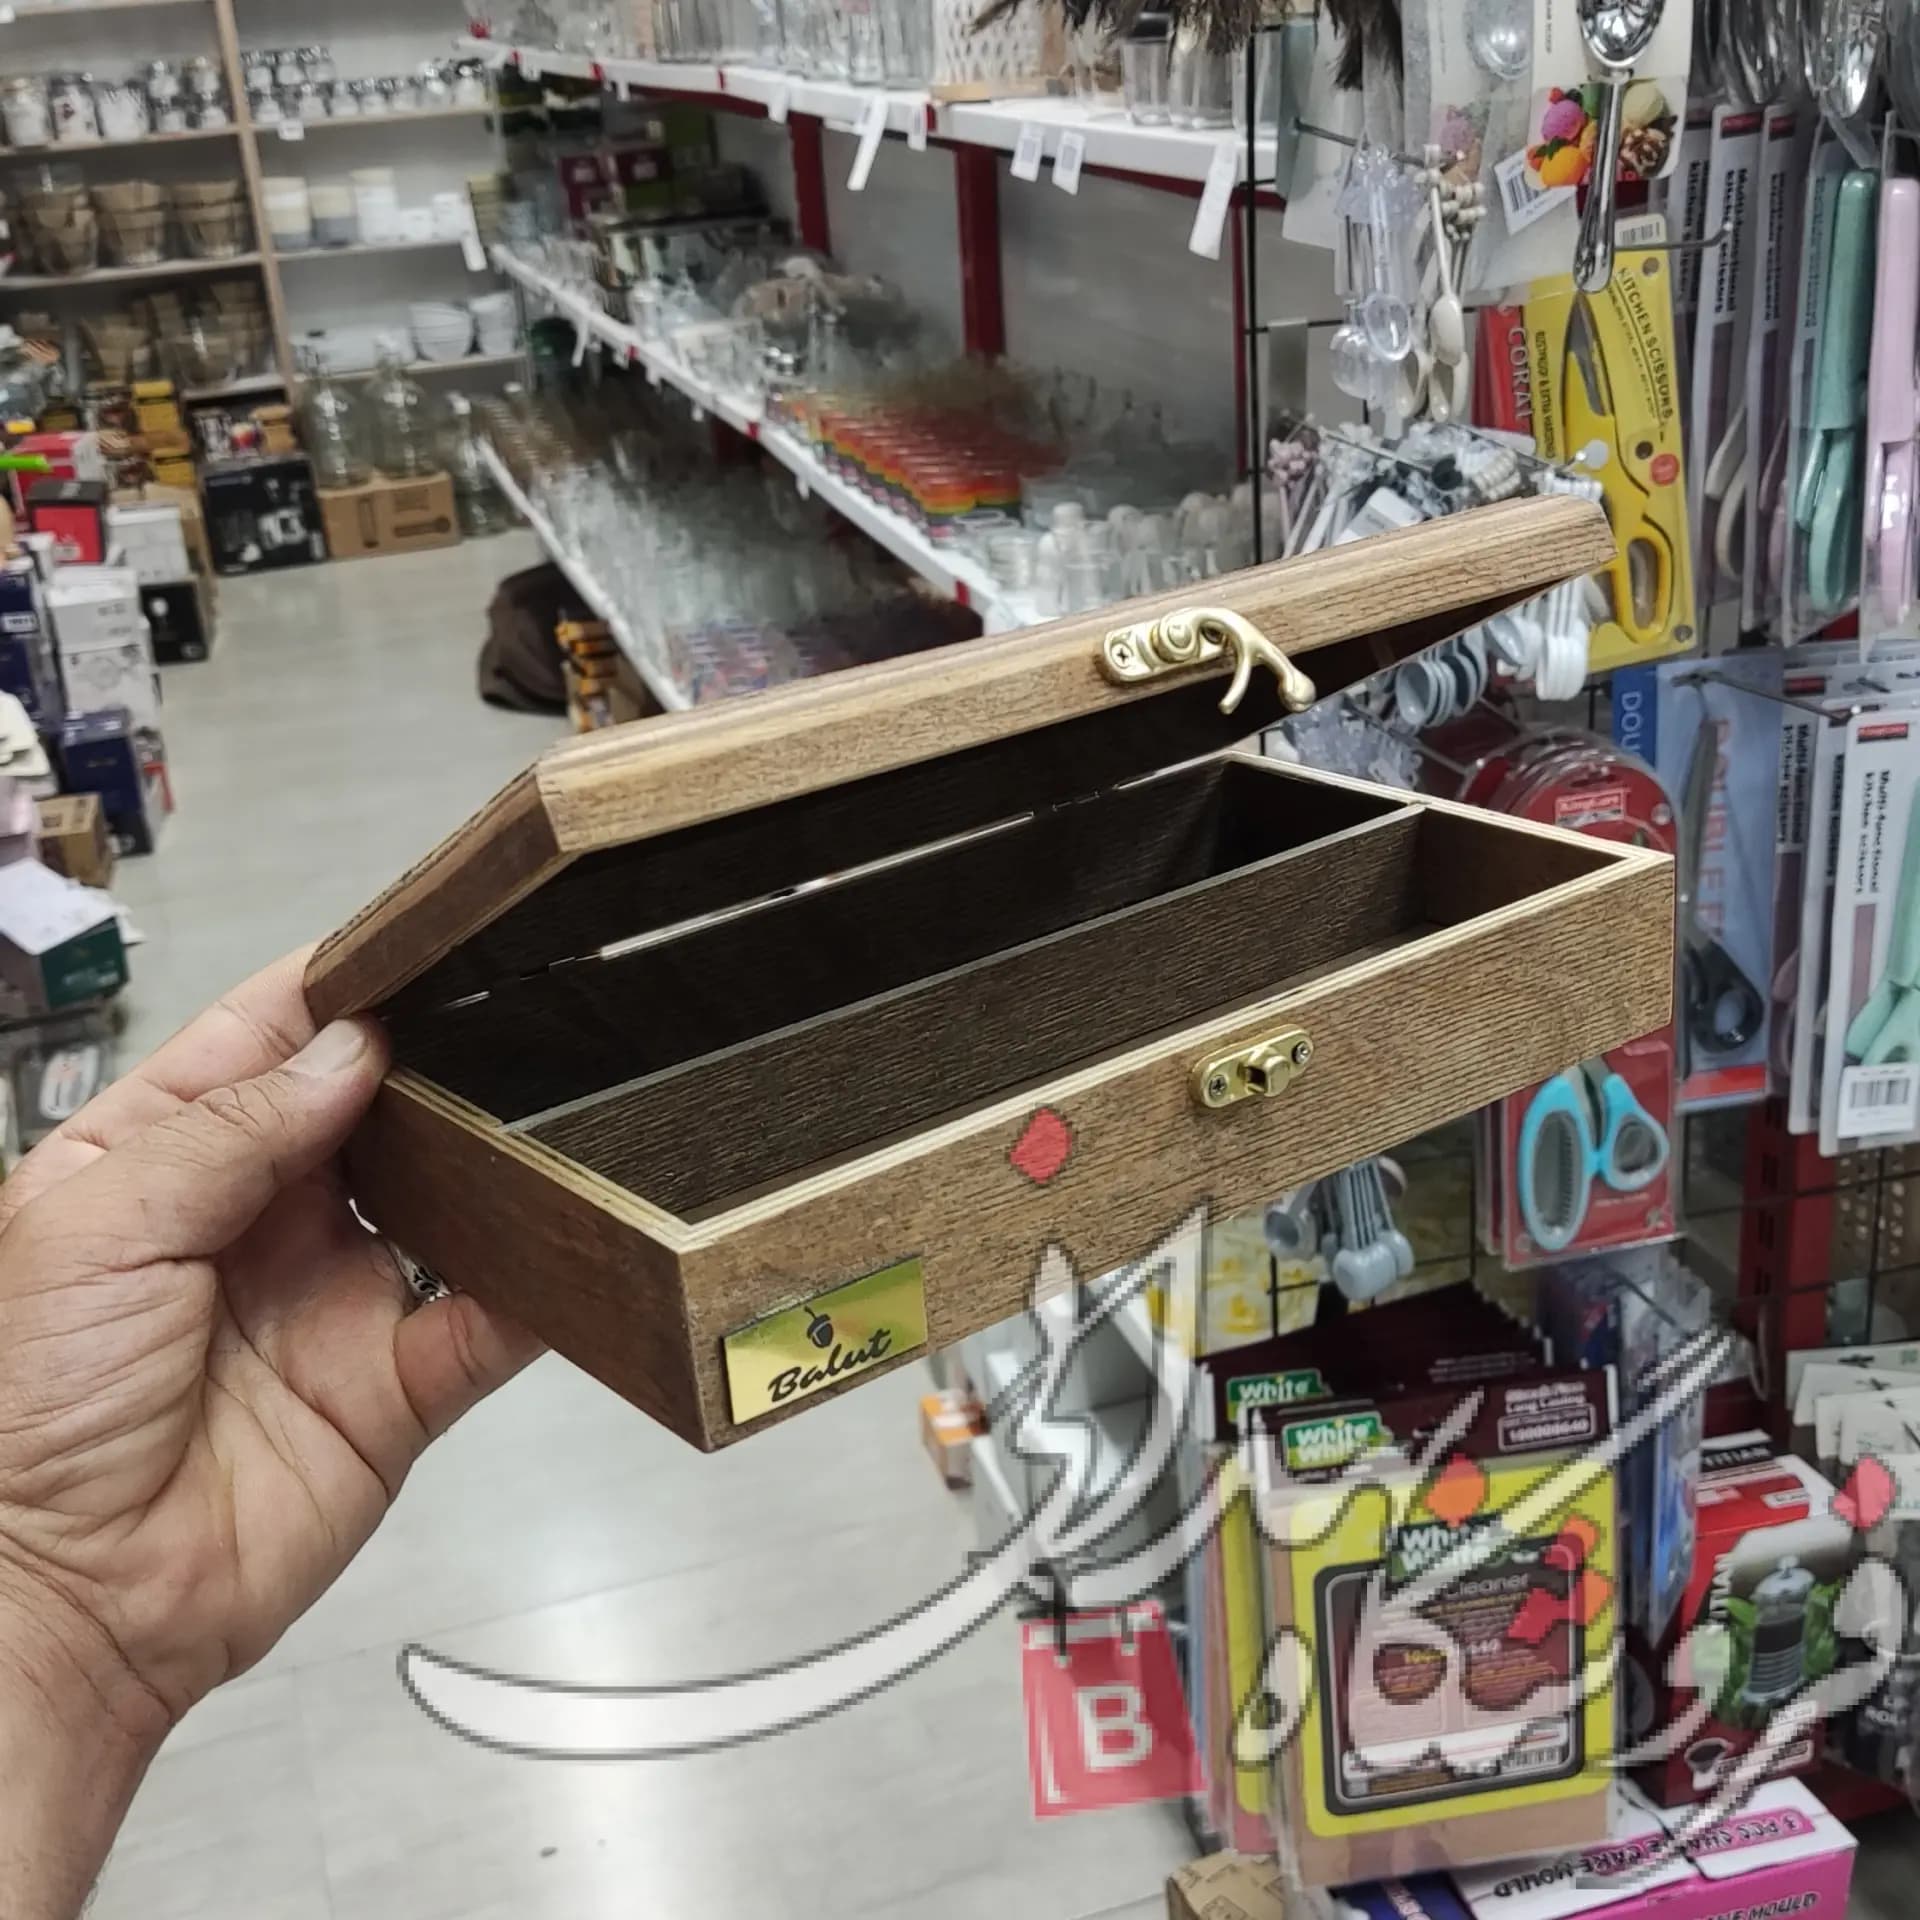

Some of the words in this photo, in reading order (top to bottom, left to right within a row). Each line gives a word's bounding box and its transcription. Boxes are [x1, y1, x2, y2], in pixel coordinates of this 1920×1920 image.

[1617, 266, 1653, 336] KITCHEN
[1646, 336, 1674, 420] SCISSORS
[766, 1327, 893, 1404] Balut
[1237, 1373, 1310, 1406] White
[1296, 1418, 1371, 1446] White
[1492, 1862, 1574, 1899] MOULD
